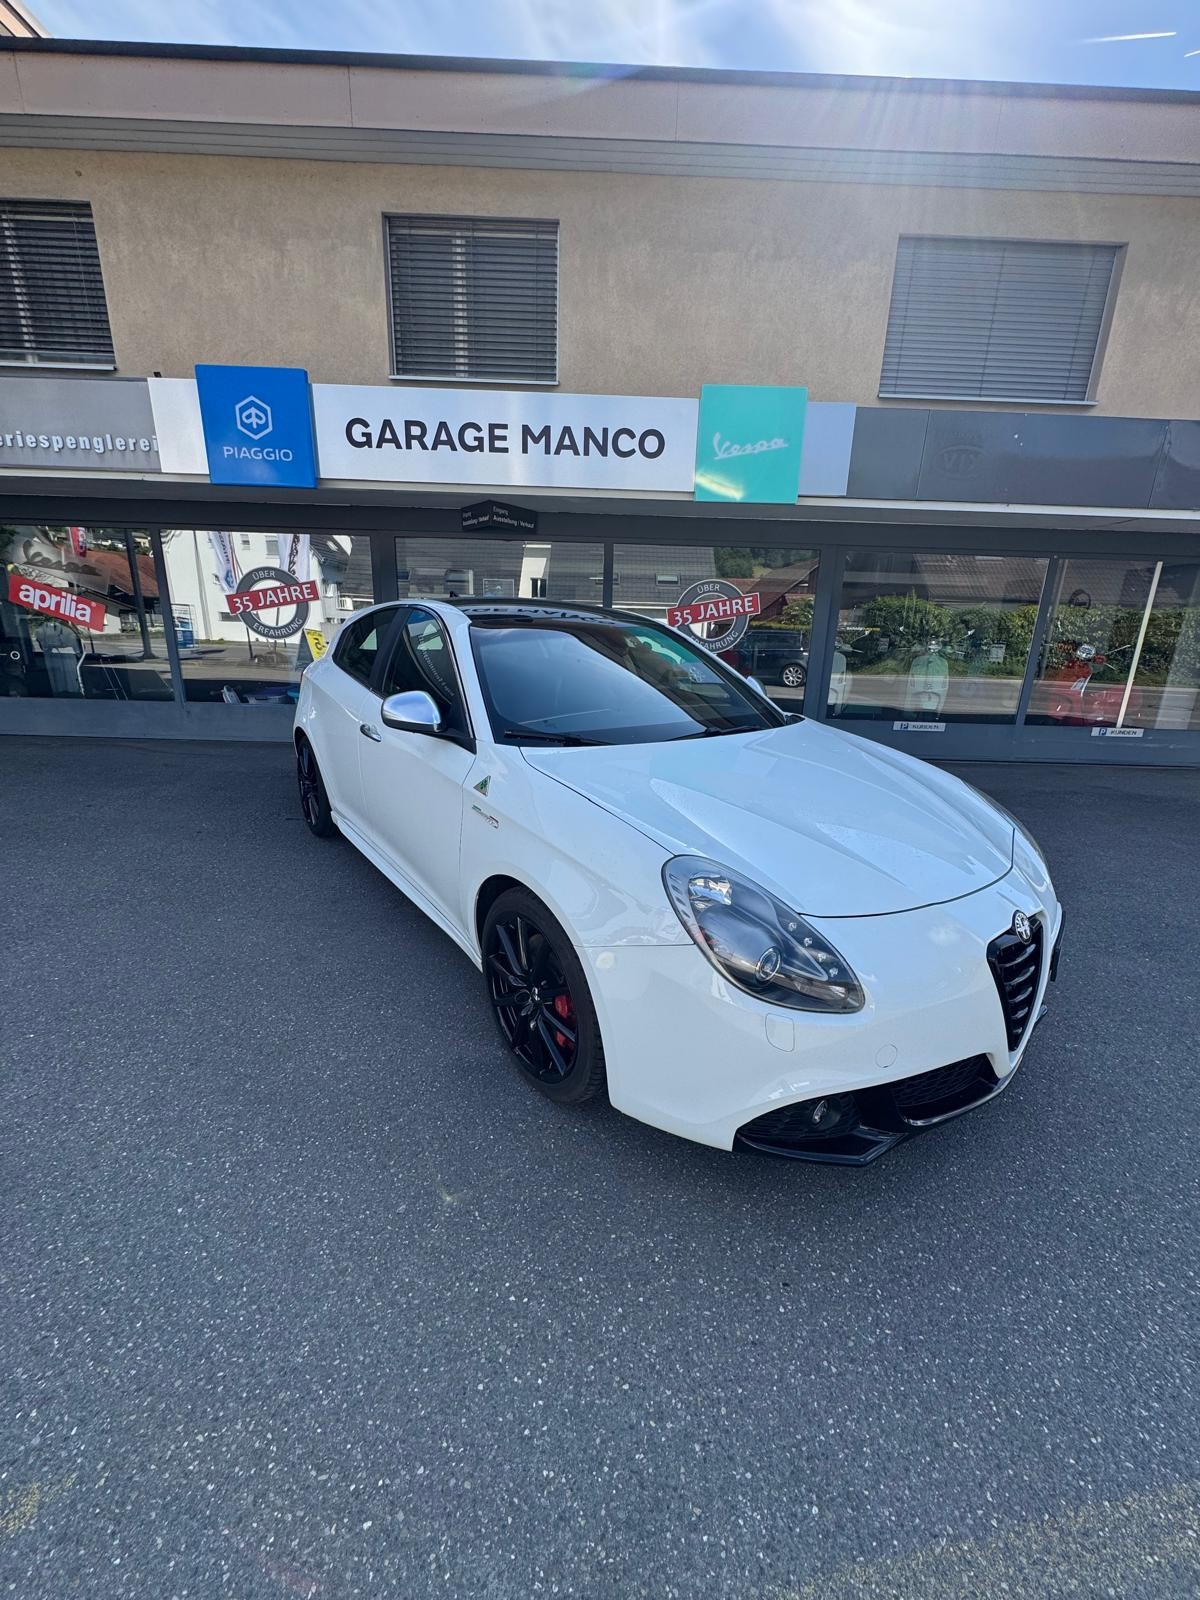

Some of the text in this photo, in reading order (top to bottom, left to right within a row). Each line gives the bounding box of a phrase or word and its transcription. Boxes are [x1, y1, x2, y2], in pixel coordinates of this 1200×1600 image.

[345, 417, 666, 459] GARAGE MANCO
[713, 431, 789, 460] Vespa
[222, 446, 293, 462] PIAGGIO
[252, 569, 276, 581] ÜBER
[697, 583, 720, 594] ÜBER
[18, 584, 91, 623] aprilia
[232, 584, 314, 614] 35 JAHRE
[673, 597, 754, 627] 35 JAHRE
[252, 617, 303, 637] ERFAHRUNG
